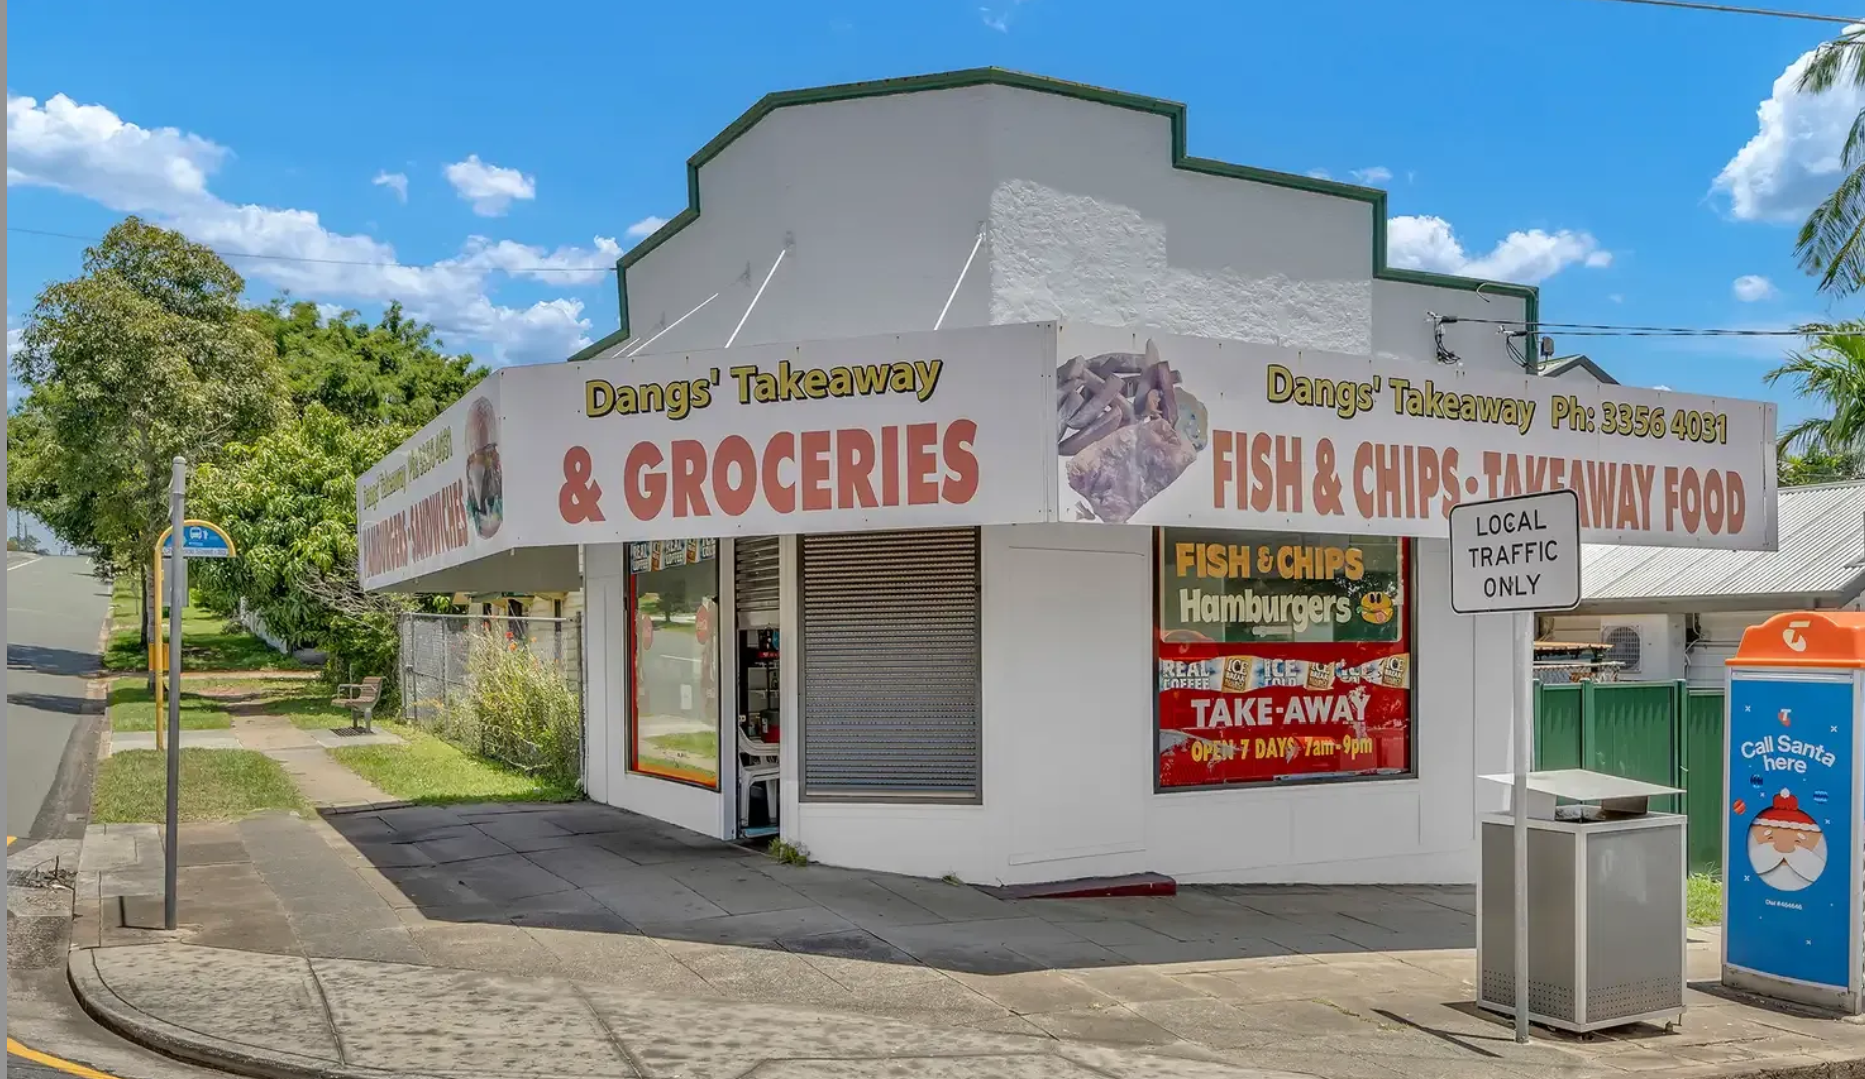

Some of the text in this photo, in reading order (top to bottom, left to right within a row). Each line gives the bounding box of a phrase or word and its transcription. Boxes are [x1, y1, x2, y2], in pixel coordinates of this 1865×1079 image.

[585, 358, 943, 420] Dangs' Takeaway
[1267, 364, 1727, 444] Dangs' Takeaway Ph: 3356 4031
[558, 418, 980, 524] & GROCERIES
[1212, 429, 1302, 513] FISH
[1313, 438, 1345, 516] &
[1353, 441, 1460, 520] CHIPS
[1664, 466, 1746, 535] FOOD
[1476, 509, 1547, 536] LOCAL
[1175, 543, 1364, 581] FISH & CHIPS
[1468, 540, 1558, 568] TRAFFIC
[1484, 573, 1541, 598] ONLY
[1179, 588, 1352, 632] Hamburgers
[1162, 660, 1210, 677] REAL
[1228, 659, 1248, 675] ICE
[1264, 658, 1297, 677] ICE
[1190, 694, 1371, 729] TAKE-AWAY
[1191, 739, 1234, 762] OPEN
[1240, 739, 1250, 760] 7
[1255, 737, 1294, 759] DAYS
[1741, 734, 1836, 768] Call Santa
[1763, 754, 1807, 774] here
